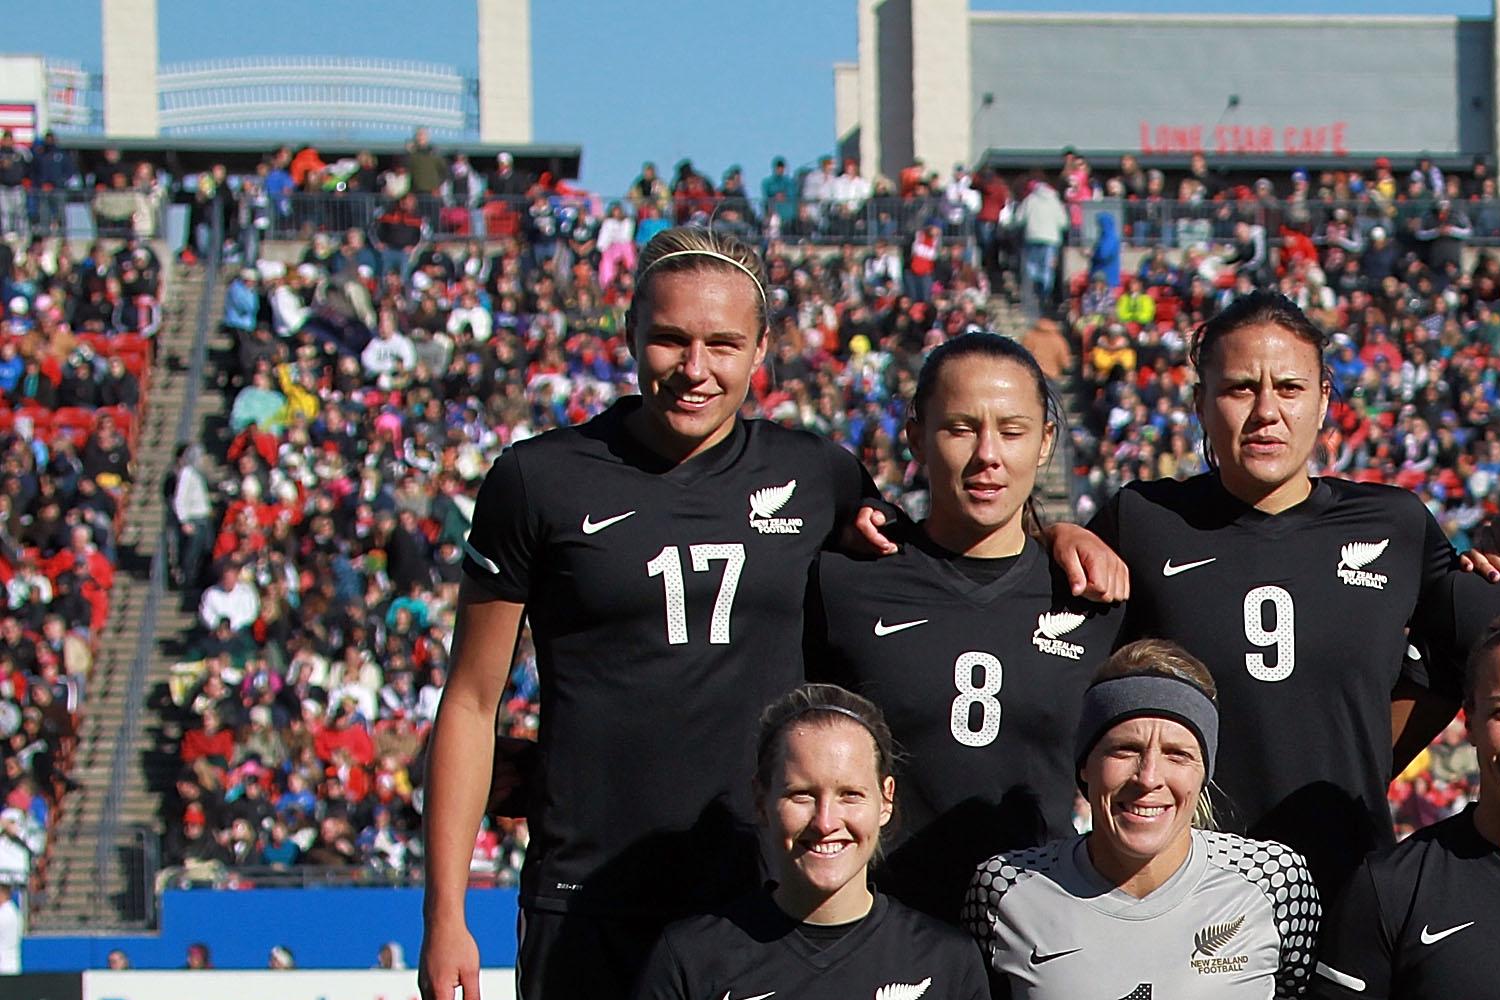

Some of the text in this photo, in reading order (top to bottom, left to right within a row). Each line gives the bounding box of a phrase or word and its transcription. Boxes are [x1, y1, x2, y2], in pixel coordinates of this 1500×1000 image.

[1140, 120, 1348, 156] LONE STAR CAFE
[758, 525, 801, 534] FOOTBALL
[1343, 577, 1384, 590] FOOTBALL
[647, 543, 746, 644] 17
[1243, 585, 1295, 682] 9
[1039, 645, 1080, 660] FOOTBALL
[950, 651, 1003, 747] 8
[1190, 955, 1249, 968] NEW ZEALAND
[1198, 963, 1244, 974] FOOTBALL
